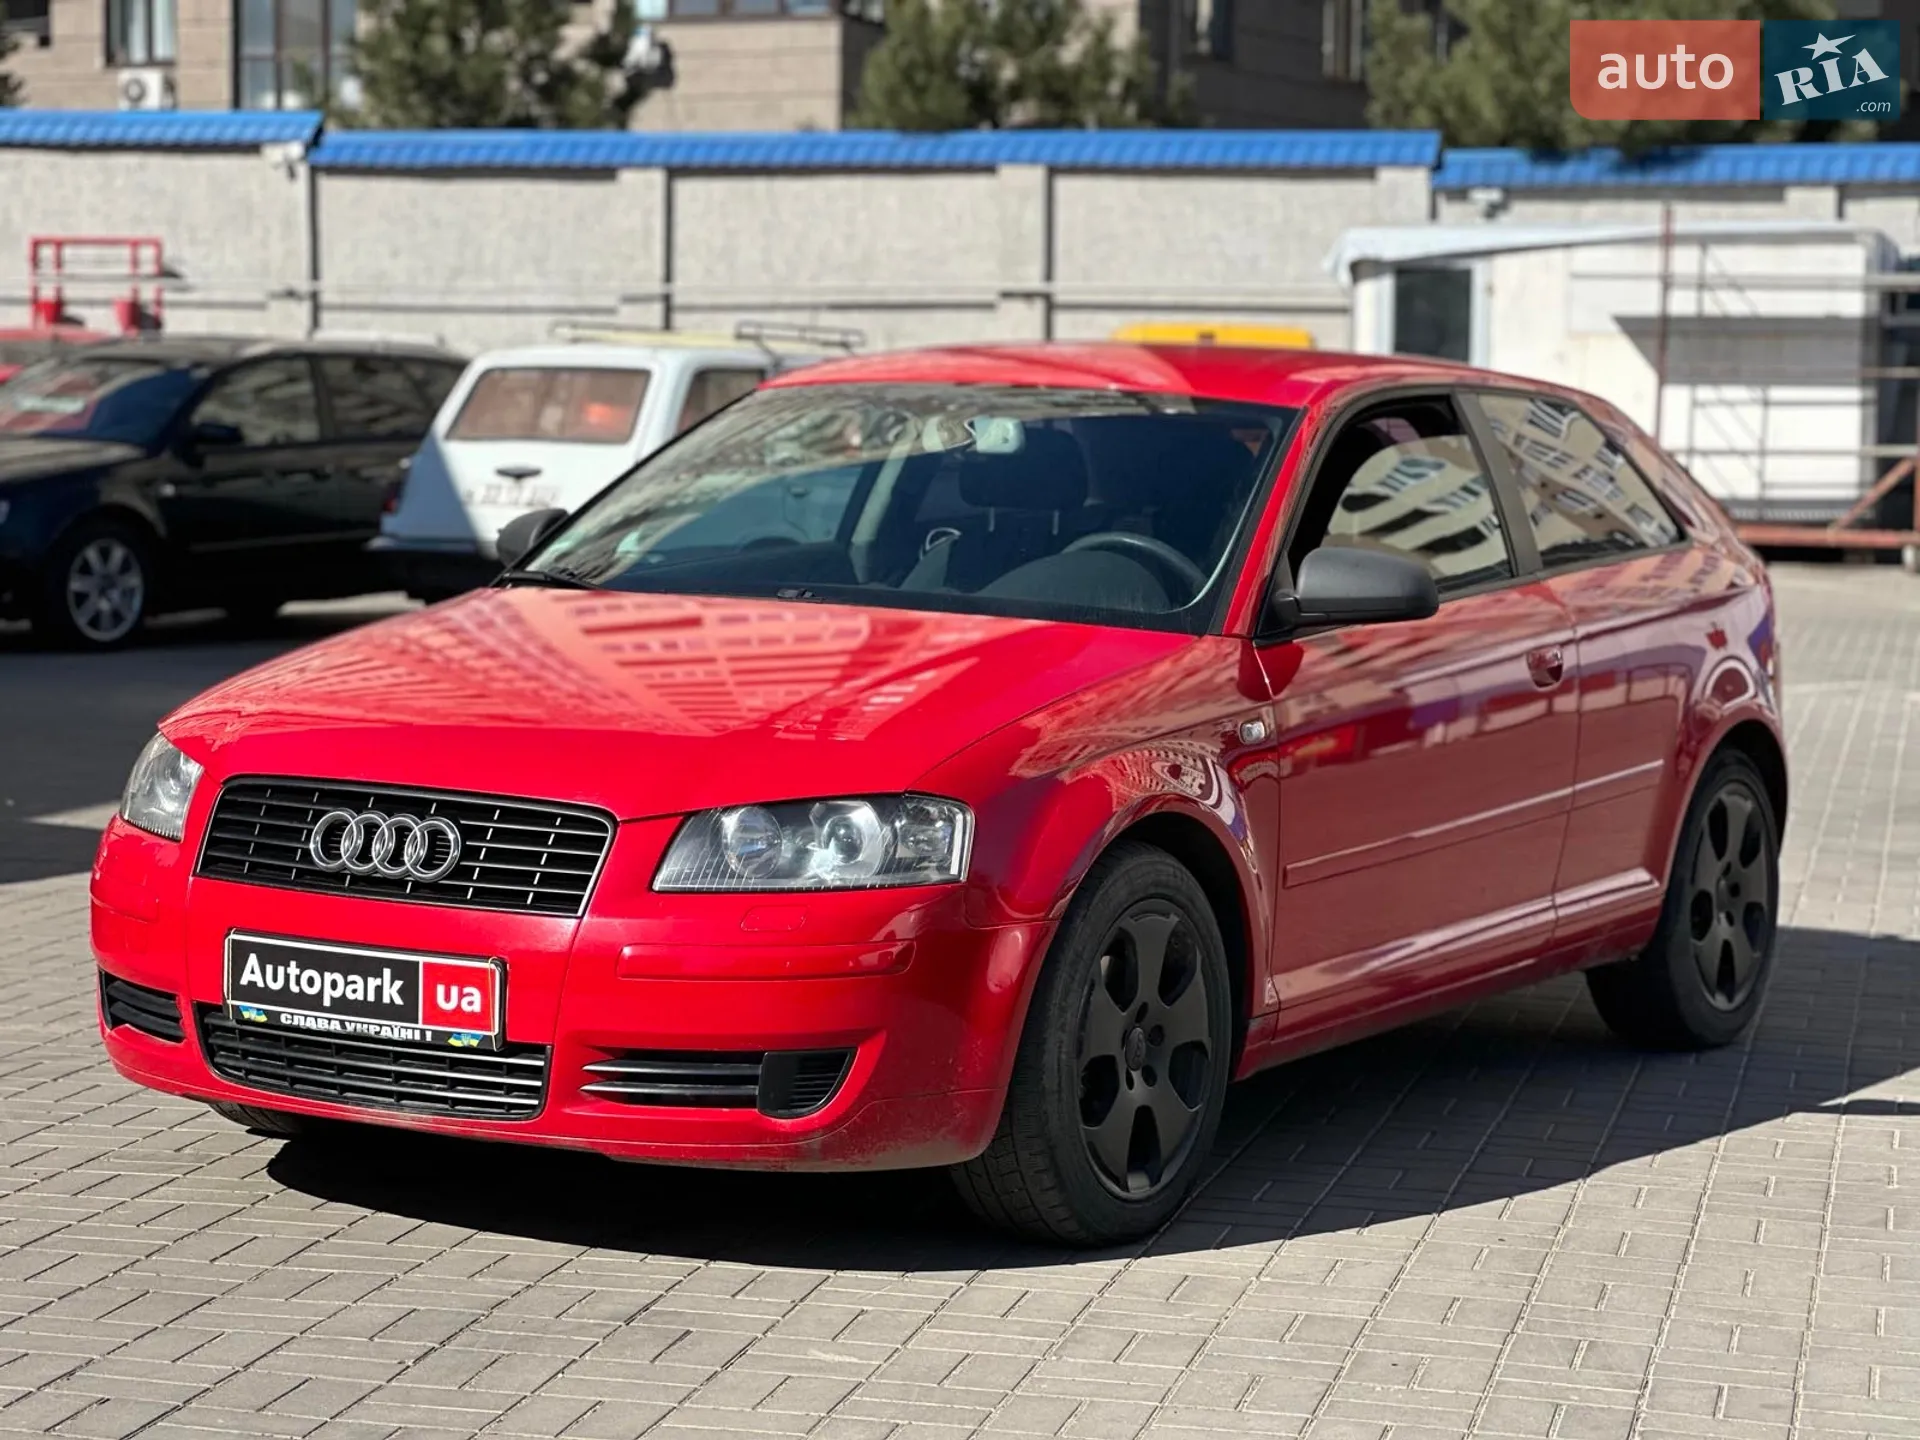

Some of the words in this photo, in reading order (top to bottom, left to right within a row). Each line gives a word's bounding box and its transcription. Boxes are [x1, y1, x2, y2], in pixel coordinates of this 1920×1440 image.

[239, 952, 404, 1006] Autopark
[436, 983, 482, 1013] ua
[280, 1012, 341, 1032] СЛАВА
